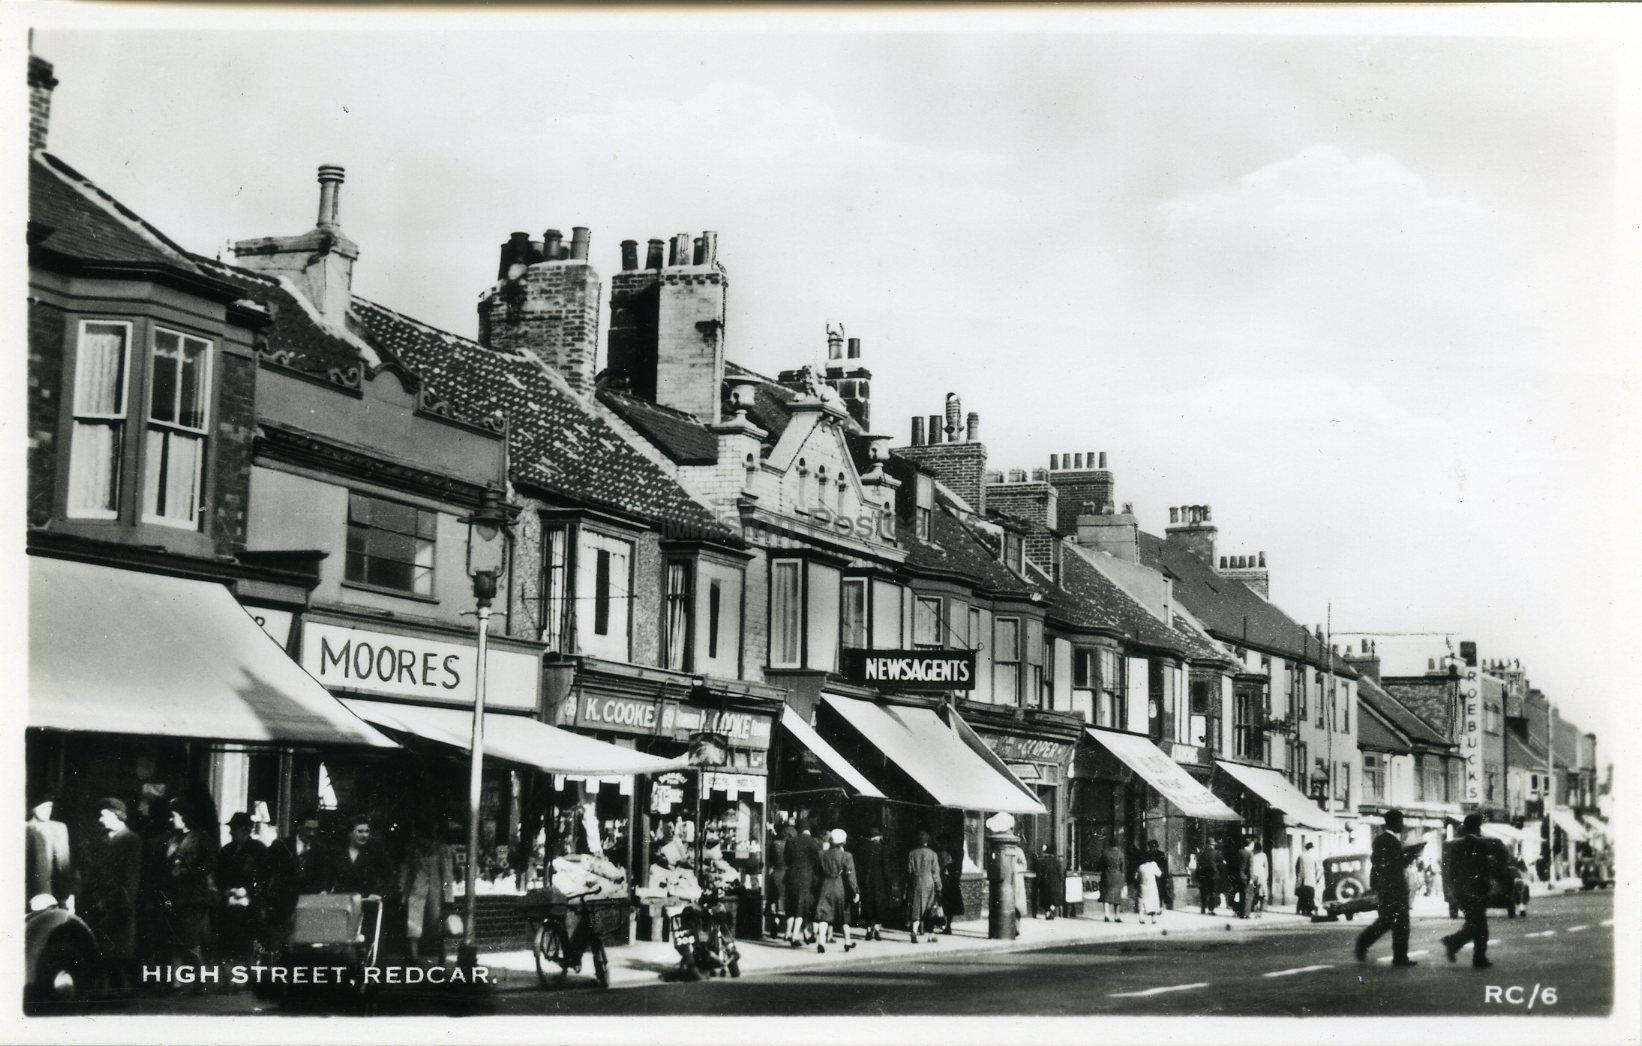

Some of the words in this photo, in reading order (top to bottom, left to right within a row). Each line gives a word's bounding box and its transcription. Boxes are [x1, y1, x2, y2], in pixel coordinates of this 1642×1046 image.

[320, 636, 461, 689] MOORES
[865, 658, 970, 682] NEWSAGENTS
[1467, 671, 1478, 799] ROEBUCKS
